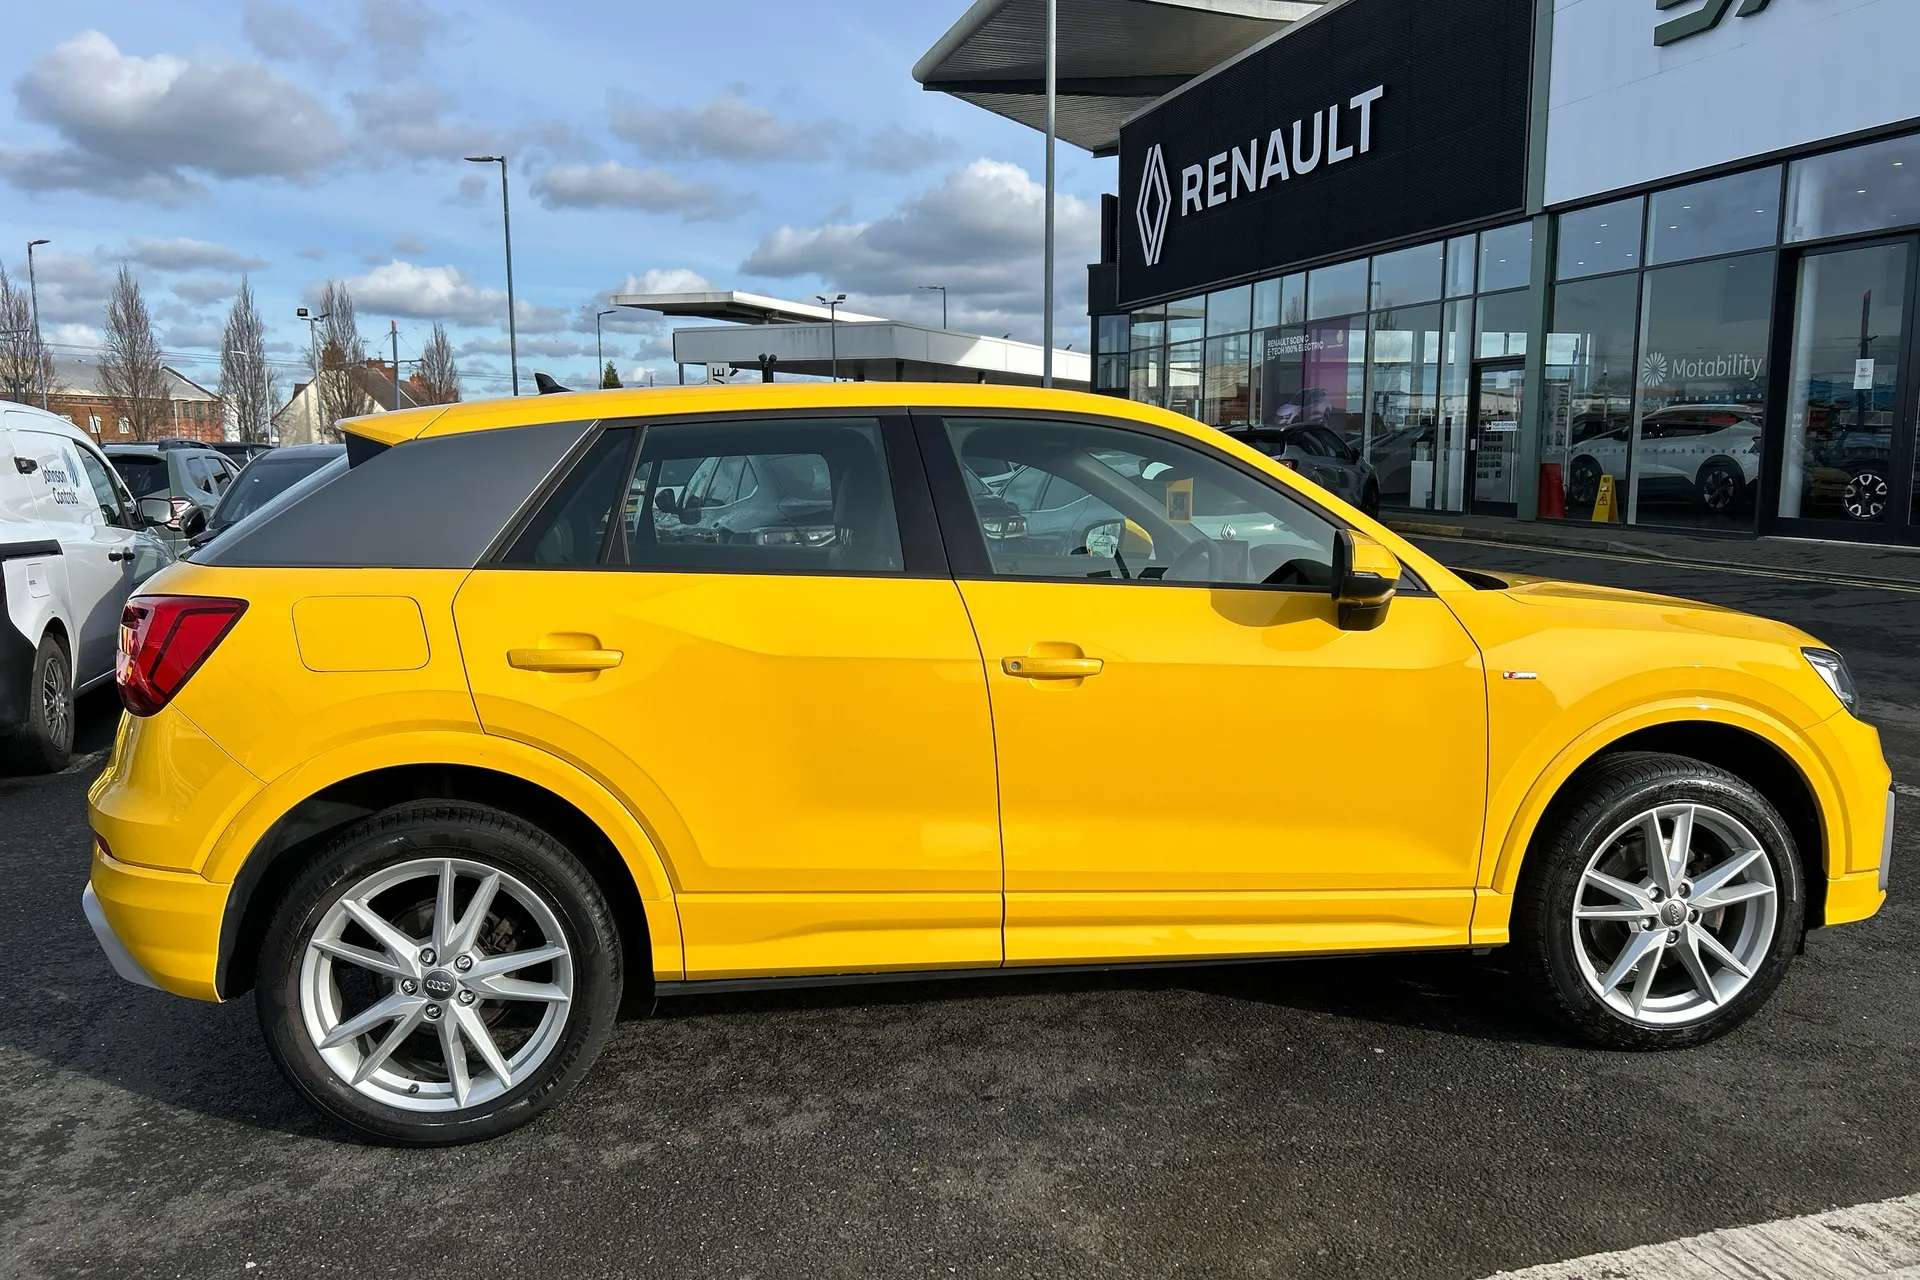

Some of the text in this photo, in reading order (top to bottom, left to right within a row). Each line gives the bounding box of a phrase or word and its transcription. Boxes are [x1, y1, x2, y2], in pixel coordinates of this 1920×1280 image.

[1182, 84, 1384, 217] RENAULT
[1267, 335, 1309, 347] RENAULT SCENC
[1671, 353, 1763, 381] Motability
[40, 464, 68, 485] Johnson
[52, 487, 79, 505] Controls
